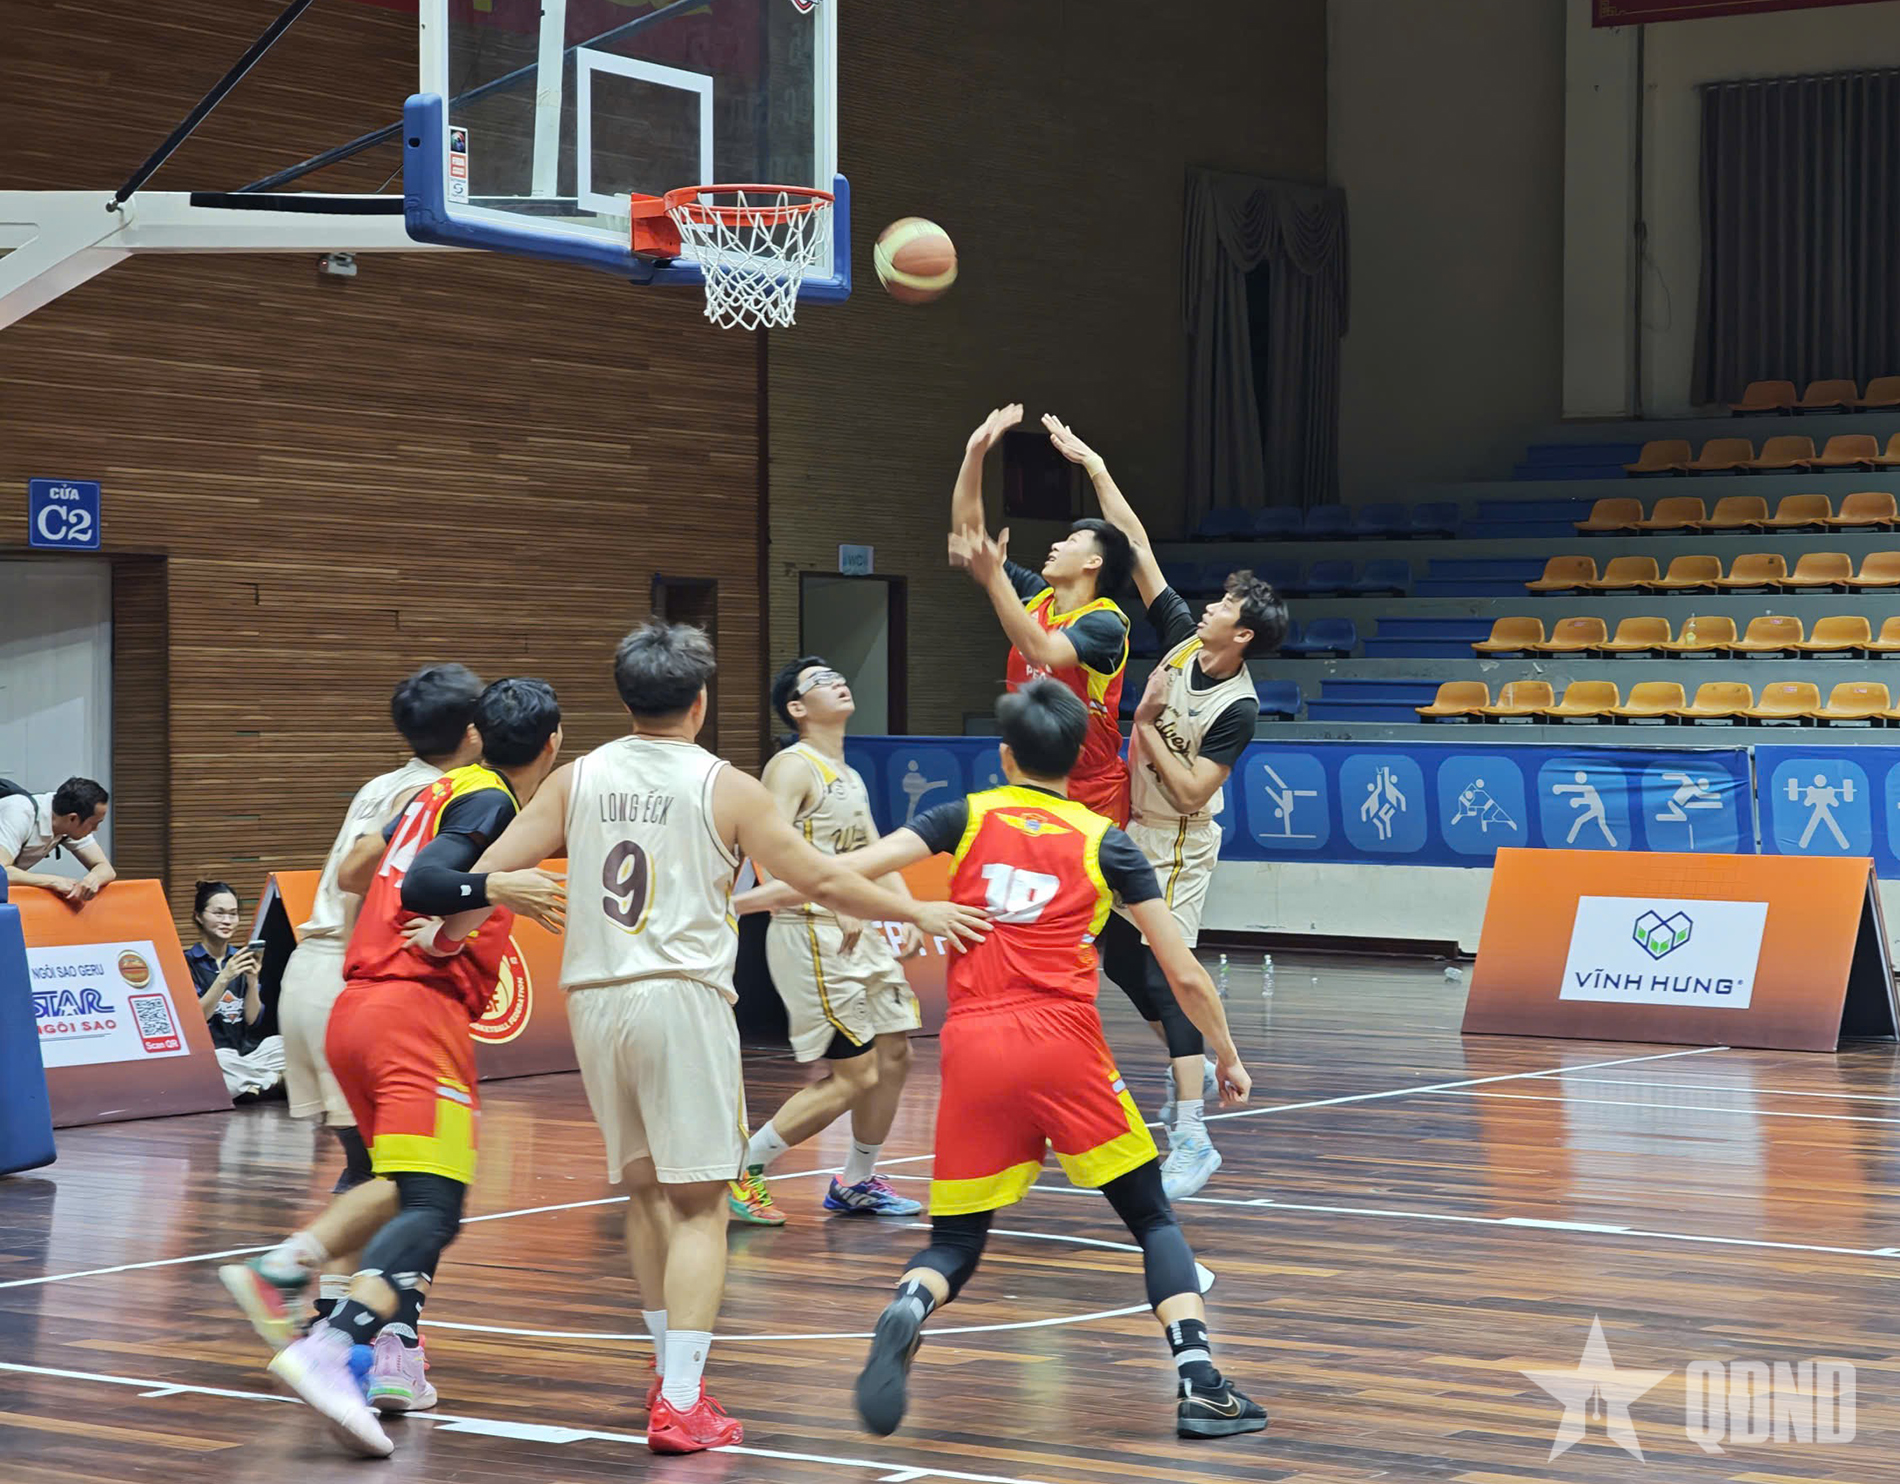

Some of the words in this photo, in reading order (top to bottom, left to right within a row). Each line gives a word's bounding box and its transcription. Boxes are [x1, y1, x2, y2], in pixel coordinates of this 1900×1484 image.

[49, 484, 80, 500] CỬA
[37, 504, 92, 542] C2
[600, 792, 640, 822] LONG
[602, 839, 654, 932] 9
[32, 964, 55, 980] NGÔI
[58, 965, 76, 978] SAO
[1575, 968, 1643, 990] VĨNH
[1650, 975, 1733, 995] HƯNG
[81, 1019, 117, 1031] SAO
[145, 1040, 165, 1050] Scan
[165, 1039, 179, 1049] QR
